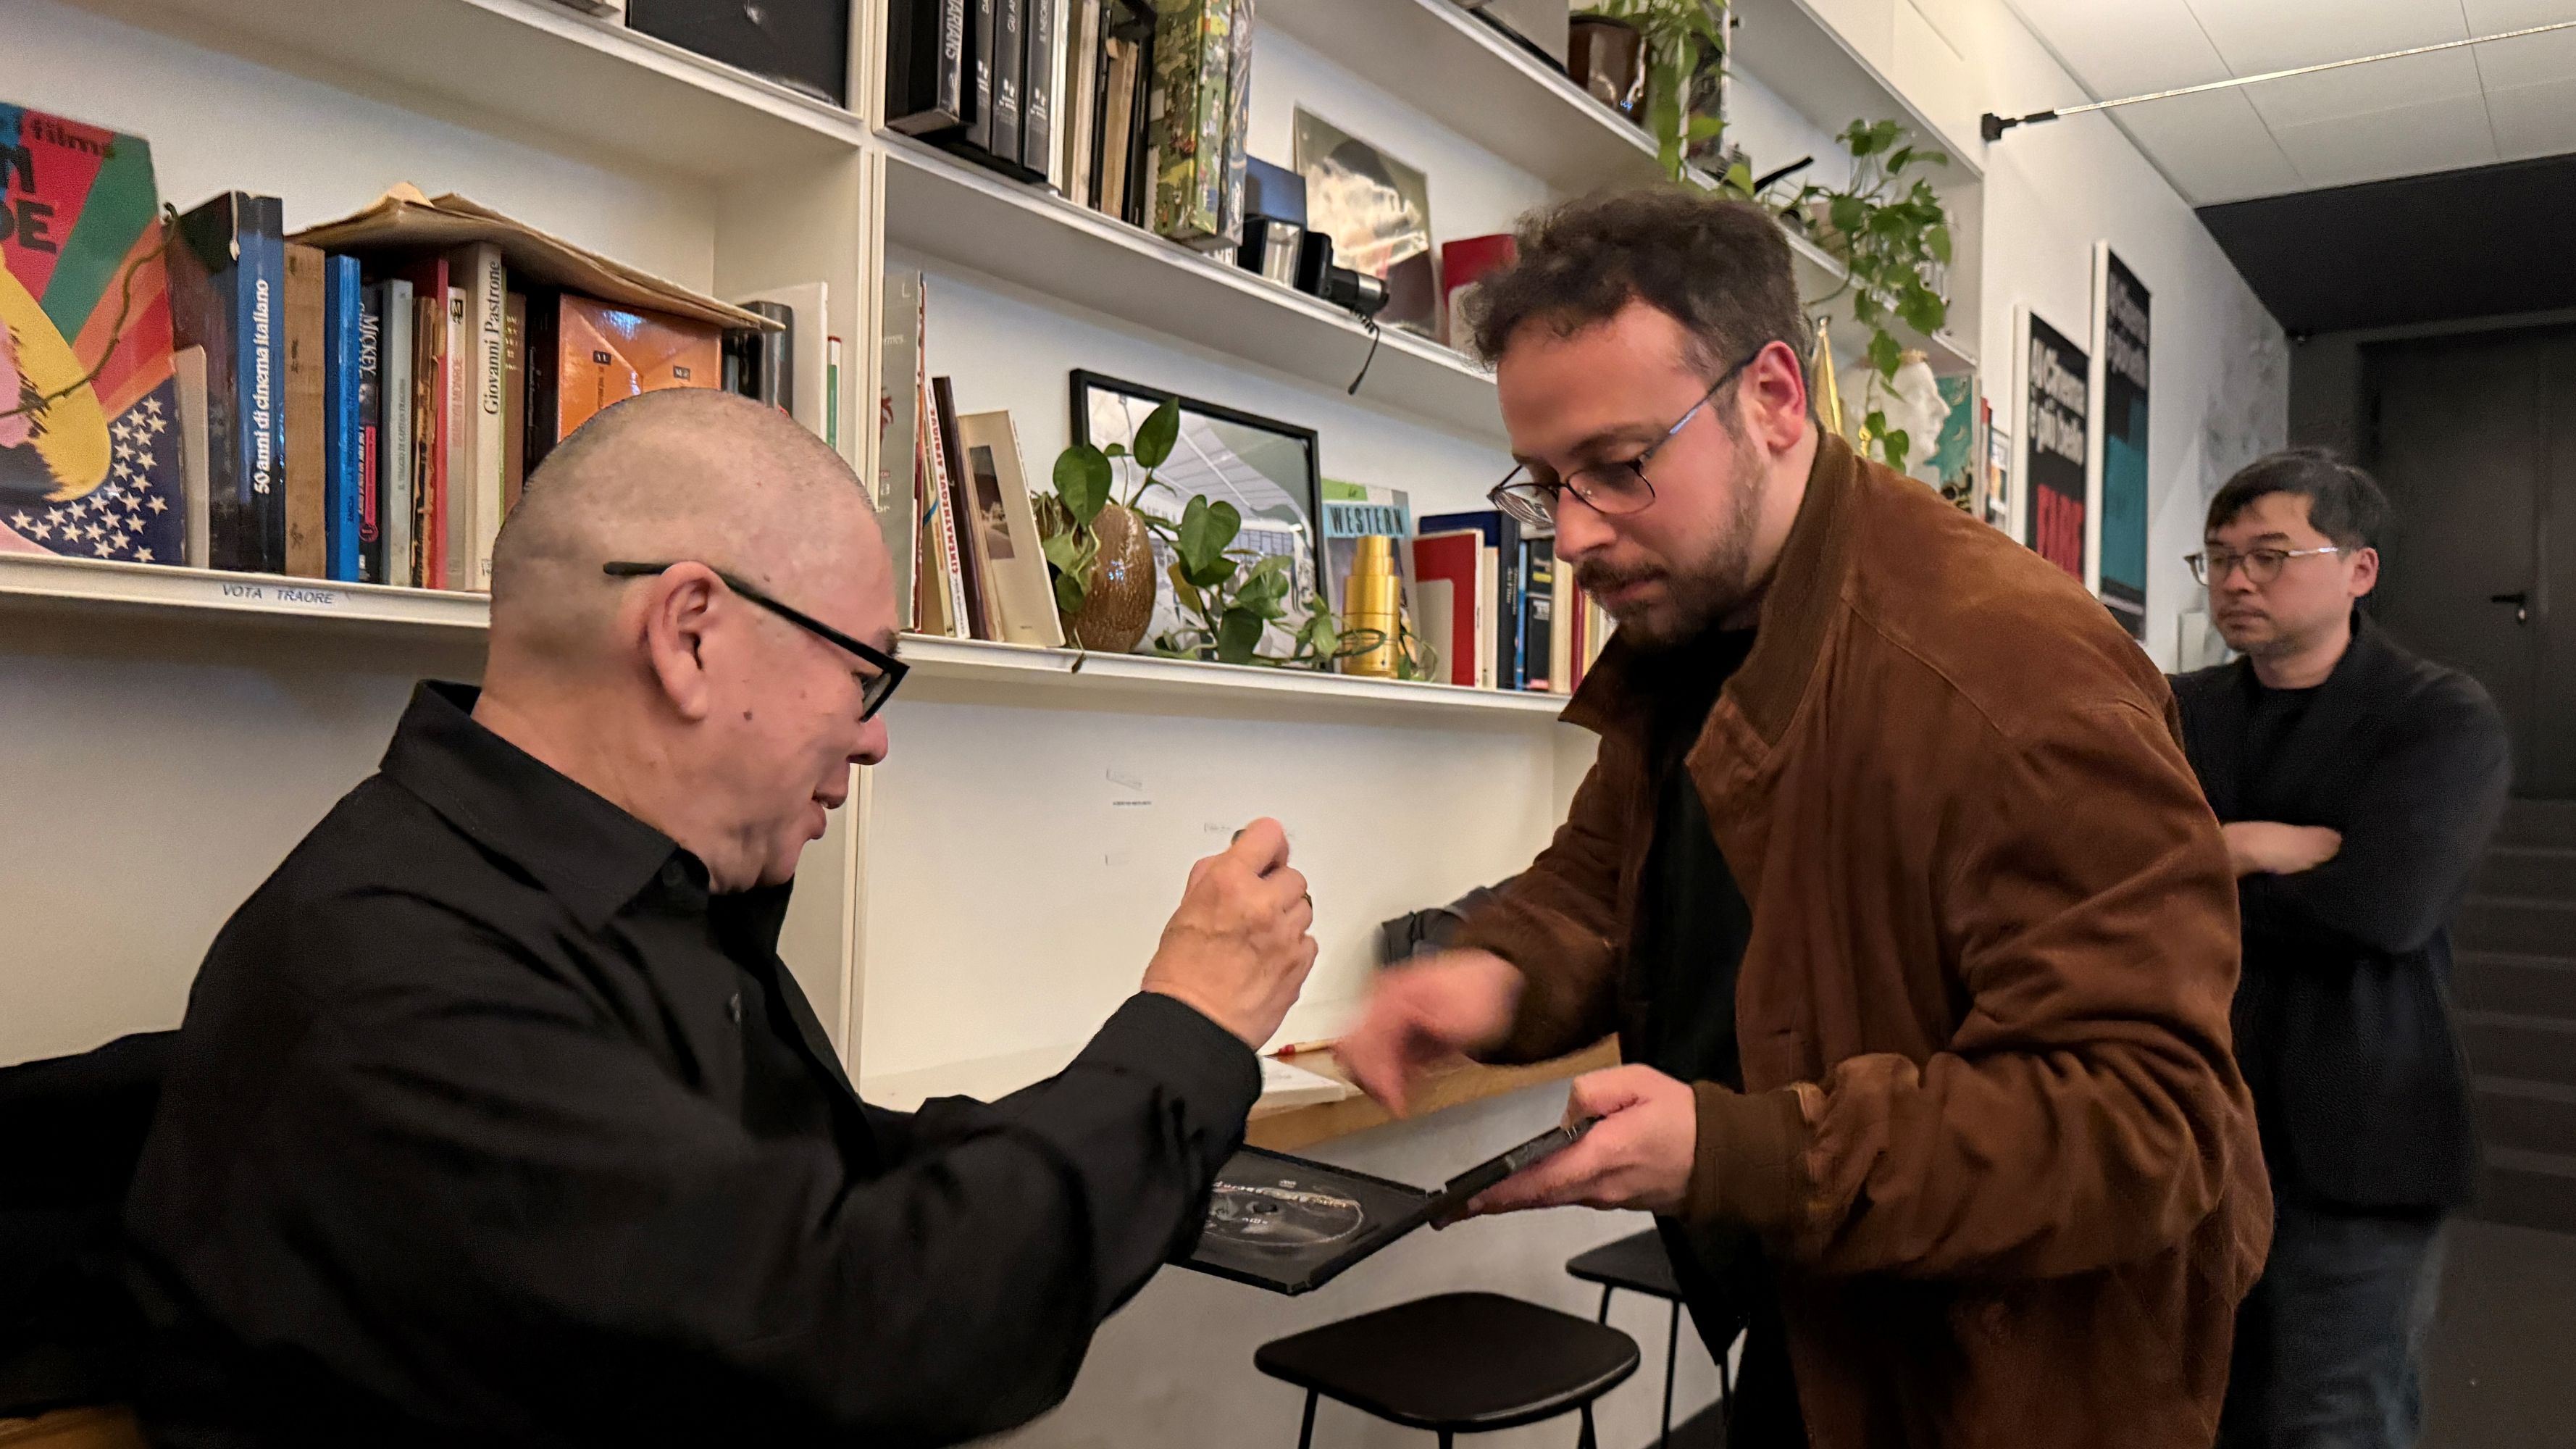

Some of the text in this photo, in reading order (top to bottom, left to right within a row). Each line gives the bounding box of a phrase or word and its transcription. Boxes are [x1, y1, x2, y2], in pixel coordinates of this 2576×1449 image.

[361, 314, 379, 376] MICKEY
[483, 260, 501, 415] Giovanni Pastrone
[252, 278, 271, 495] 50 anni di cinema italiano
[929, 408, 945, 467] AFRIQUE
[1330, 507, 1403, 535] WESTERN
[222, 584, 334, 604] VOTA TRAORE
